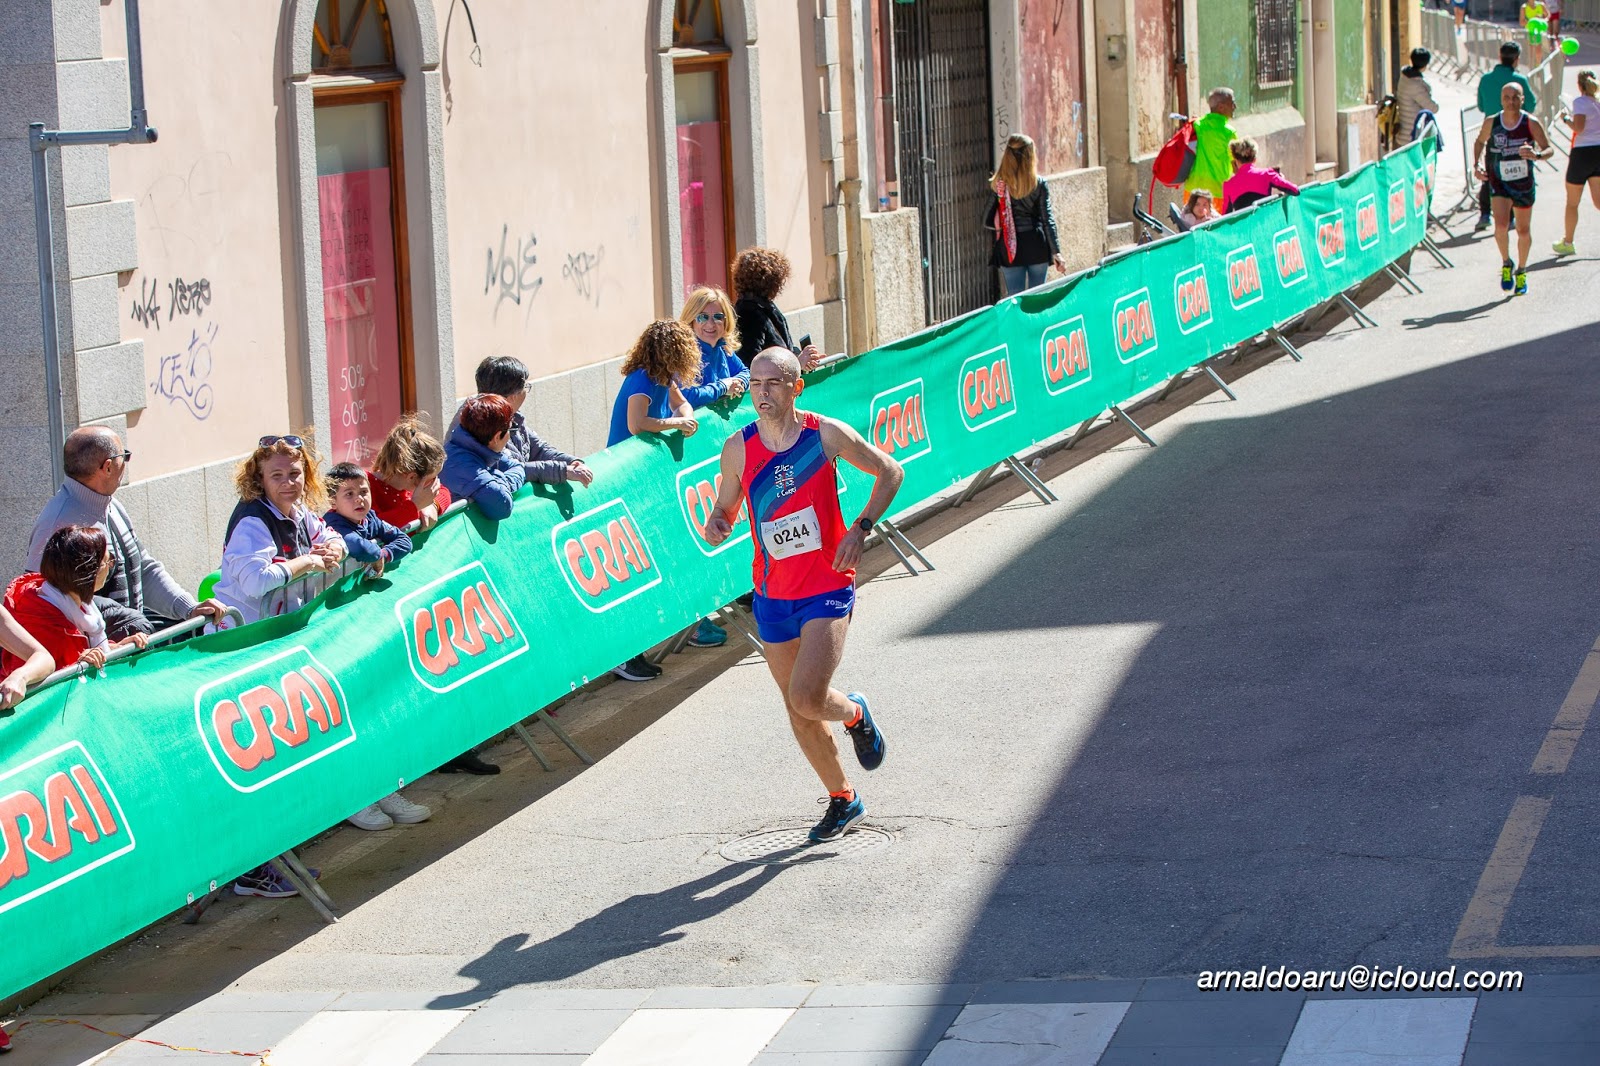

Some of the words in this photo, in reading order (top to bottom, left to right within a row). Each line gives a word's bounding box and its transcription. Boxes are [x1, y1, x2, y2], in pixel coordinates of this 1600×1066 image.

[1277, 236, 1304, 277] CRAI
[1319, 219, 1344, 258] CRAI
[1178, 276, 1209, 324] CRAI
[1230, 255, 1260, 299] CRAI
[1117, 300, 1153, 352] CRAI
[340, 364, 365, 391] 50%
[1046, 328, 1088, 383] CRAI
[342, 399, 367, 427] 60%
[963, 358, 1011, 418] CRAI
[344, 436, 370, 463] 70%
[874, 394, 925, 455] CRAI
[564, 516, 651, 597] CRAI
[773, 523, 810, 545] 0244
[415, 581, 515, 675] CRAI
[213, 666, 342, 771] CRAI
[0, 764, 118, 889] RAI
